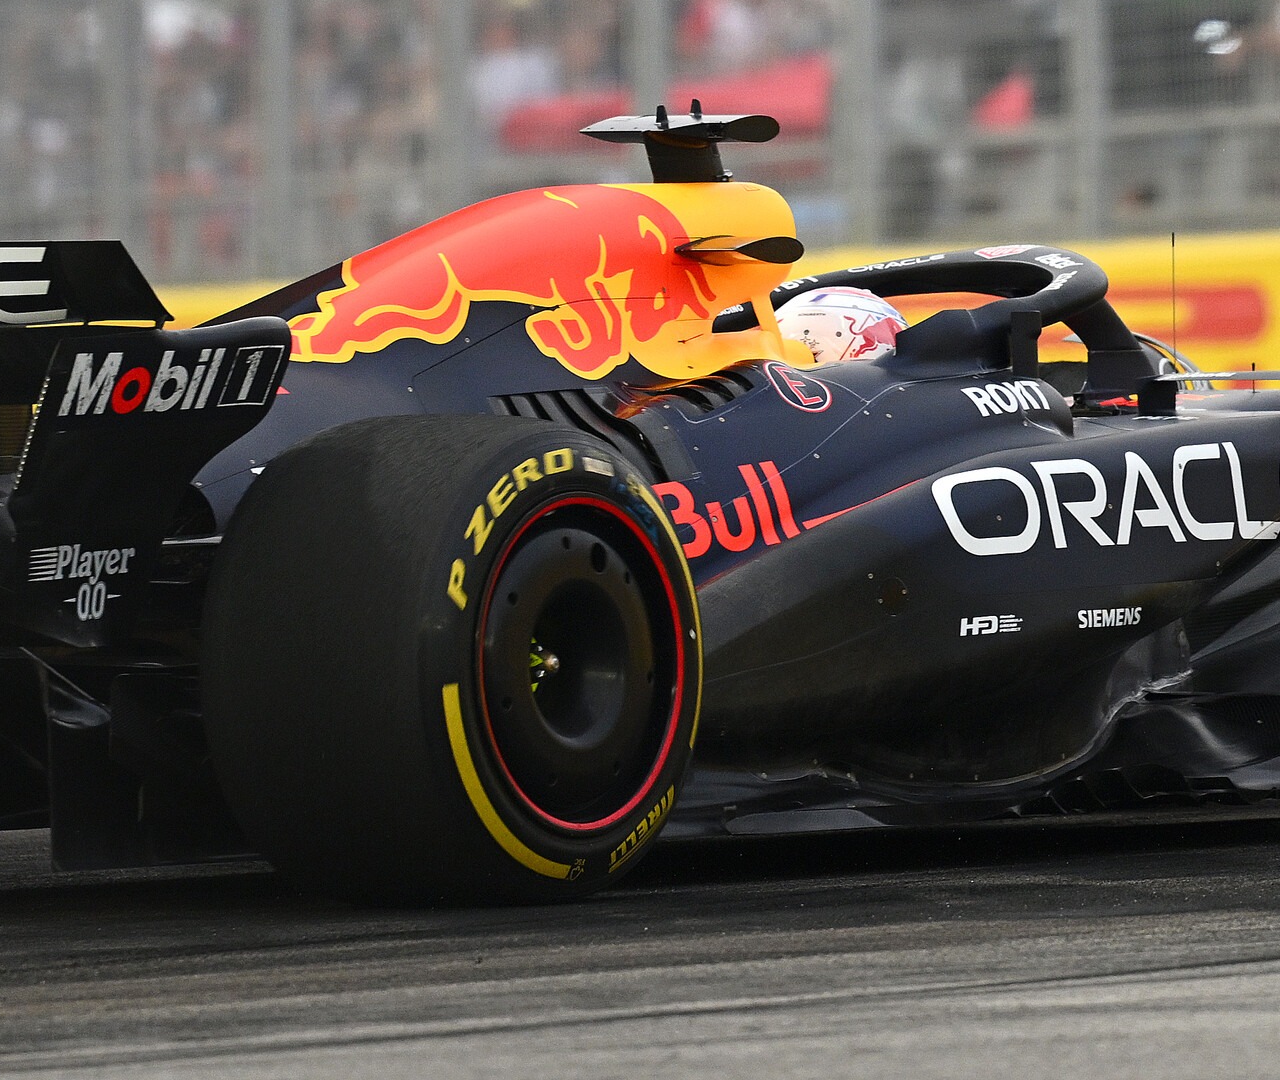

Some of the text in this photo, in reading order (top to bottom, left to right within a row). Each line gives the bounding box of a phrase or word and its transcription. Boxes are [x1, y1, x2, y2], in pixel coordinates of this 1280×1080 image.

[847, 253, 945, 273] ORACLE
[57, 347, 264, 417] Mobil 1
[464, 447, 574, 557] ZERO
[651, 460, 802, 559] Bull
[54, 543, 136, 586] Player
[1077, 606, 1142, 629] SIEMENS
[608, 784, 675, 873] PIRELLI
